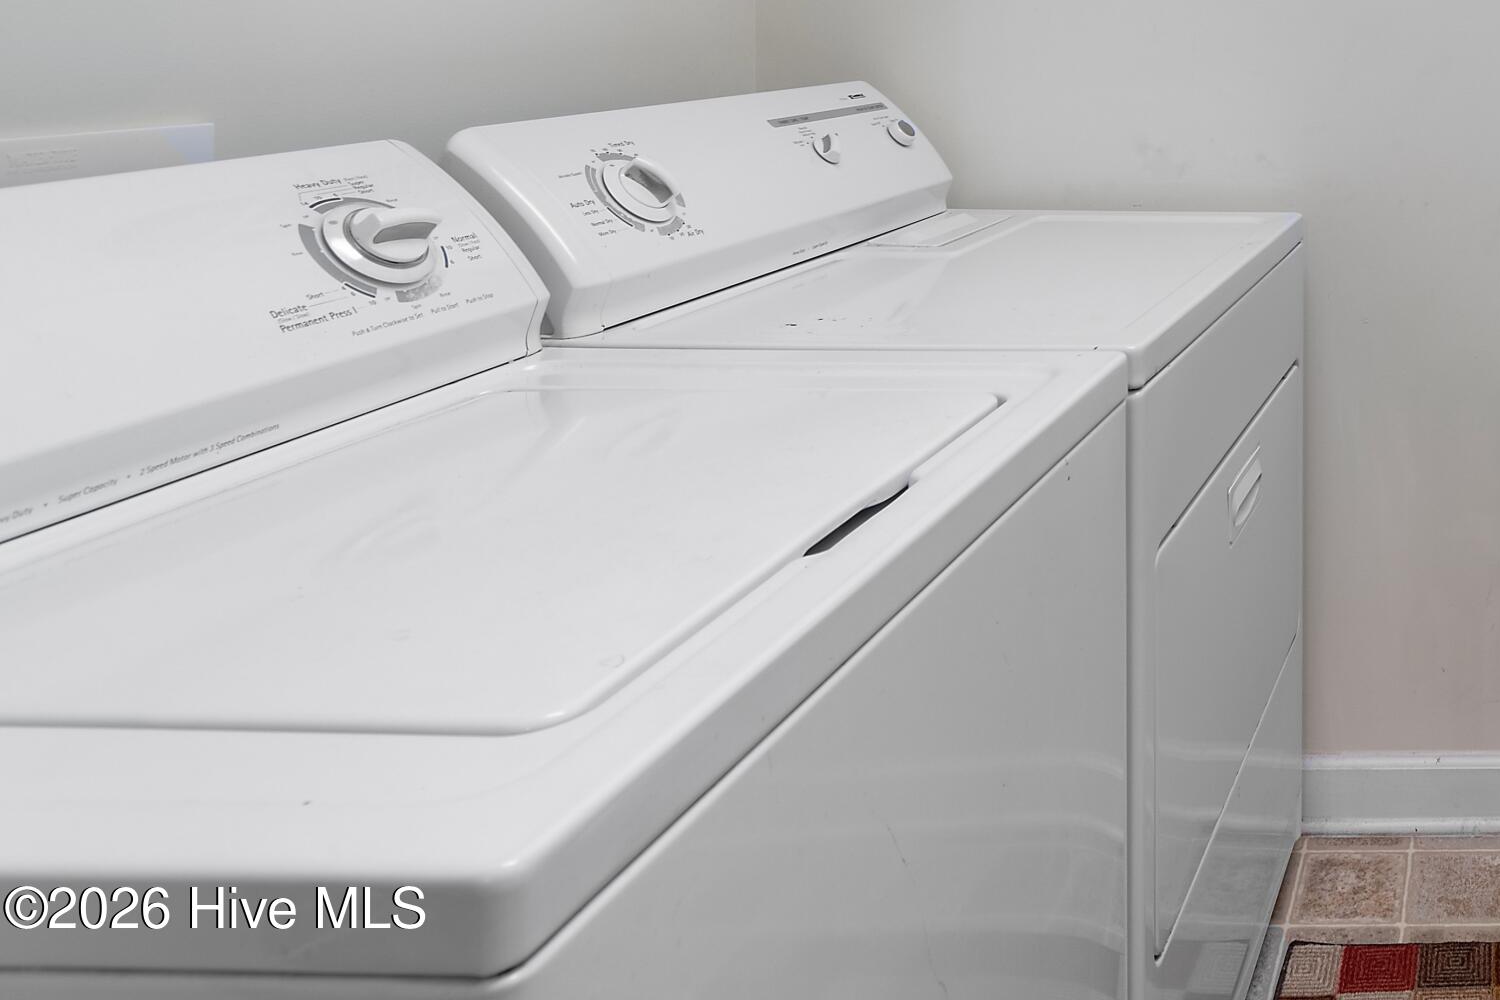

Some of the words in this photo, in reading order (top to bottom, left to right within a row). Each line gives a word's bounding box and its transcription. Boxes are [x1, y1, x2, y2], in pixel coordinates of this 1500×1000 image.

[451, 232, 477, 243] Normal
[306, 291, 325, 300] Short
[269, 304, 308, 319] Delicate
[279, 315, 329, 333] Permanent
[328, 308, 353, 321] Press
[352, 328, 366, 337] Push
[382, 317, 409, 328] Clockwise
[146, 460, 169, 474] Speed
[215, 437, 236, 450] Speed
[236, 423, 280, 442] Combinations
[58, 490, 82, 504] Super
[83, 479, 118, 495] Capacity
